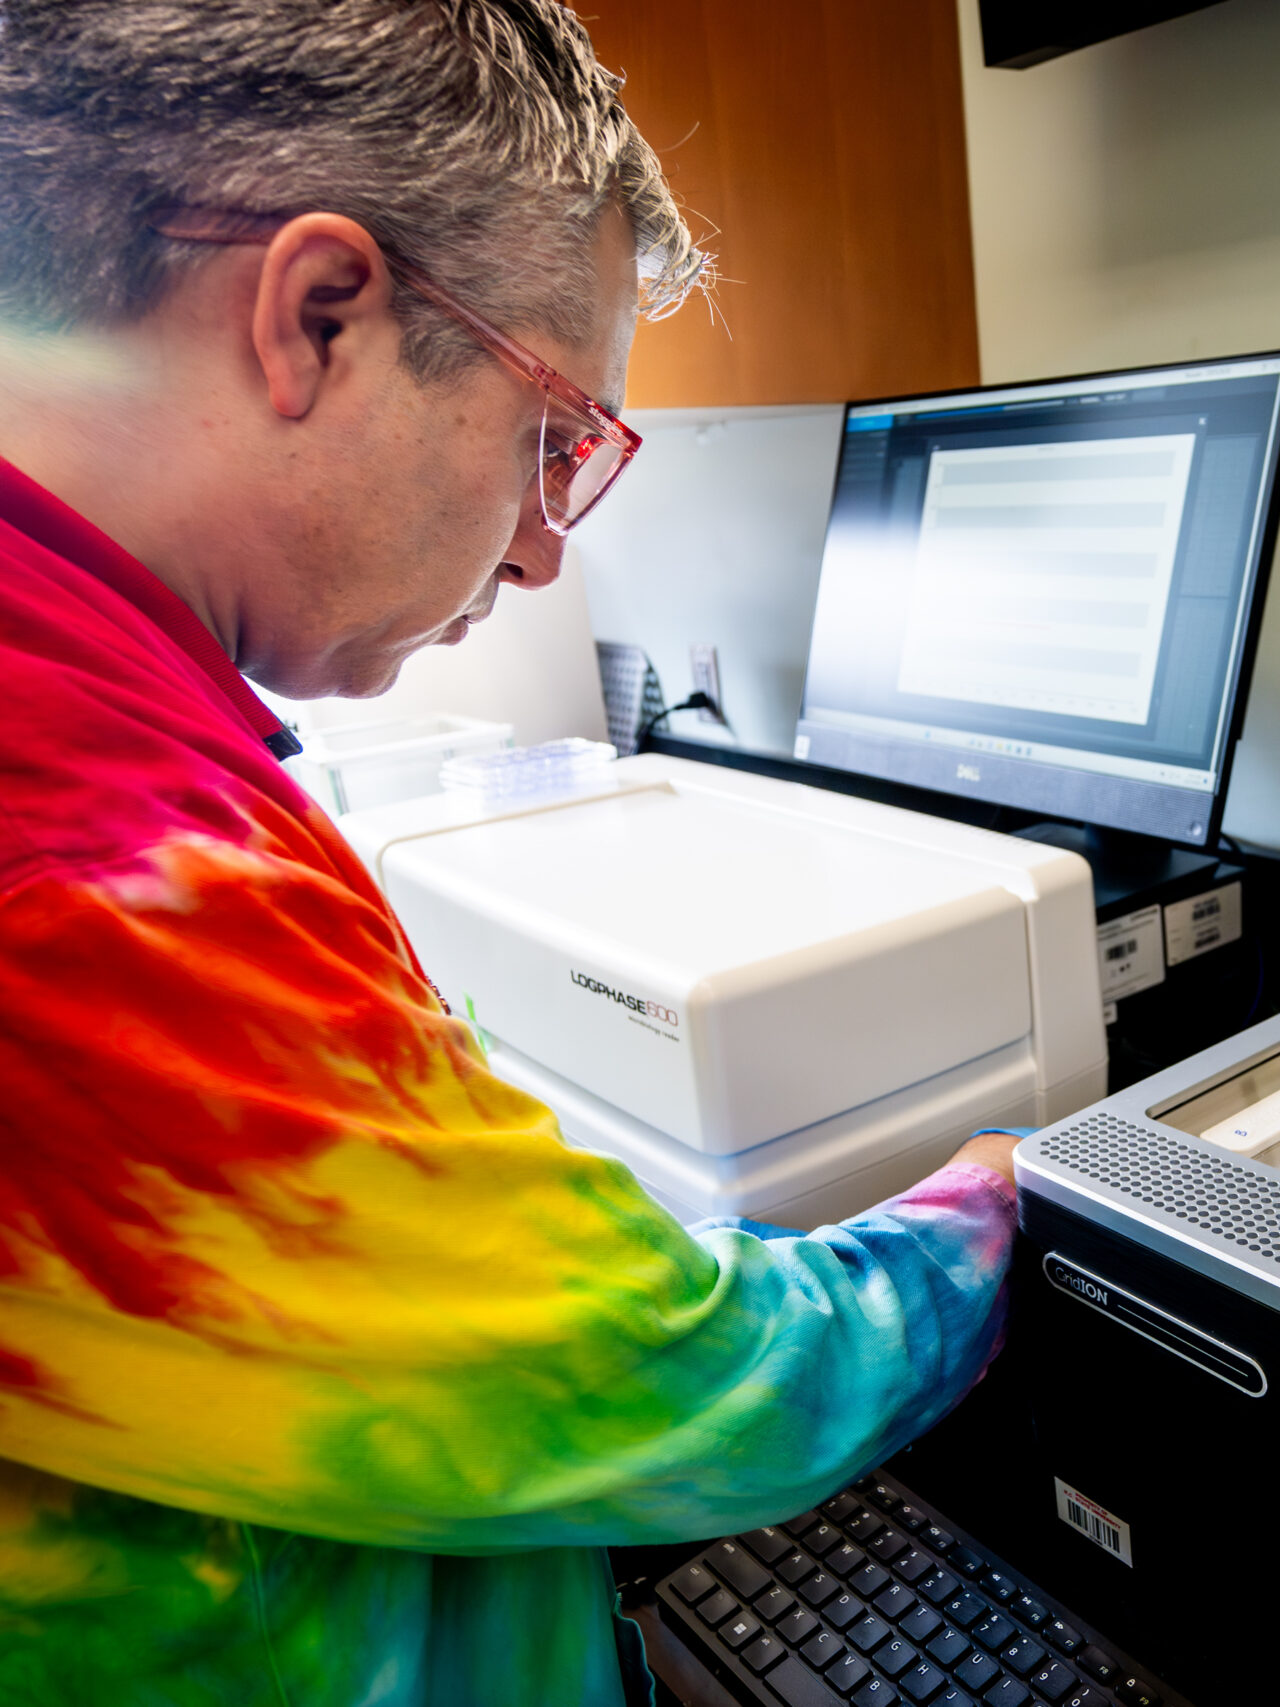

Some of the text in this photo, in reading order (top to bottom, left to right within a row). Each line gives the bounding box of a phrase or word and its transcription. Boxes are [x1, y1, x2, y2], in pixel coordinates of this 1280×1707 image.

[570, 968, 678, 1027] LOGPHASE600
[1055, 1266, 1108, 1306] GridION
[818, 1525, 828, 1535] Q
[875, 1538, 883, 1546] 3
[841, 1544, 854, 1554] W
[865, 1564, 876, 1574] E
[815, 1574, 825, 1583] S
[925, 1580, 934, 1588] 5
[770, 1588, 781, 1598] Z
[890, 1585, 900, 1595] R
[839, 1595, 849, 1604] D
[952, 1601, 961, 1609] 6
[794, 1610, 805, 1620] X
[917, 1607, 927, 1616] T
[819, 1633, 829, 1643] C
[945, 1630, 955, 1639] Y
[891, 1641, 902, 1651] G
[1009, 1648, 1018, 1656] 8
[845, 1656, 855, 1666] V
[972, 1654, 983, 1664] U
[918, 1664, 929, 1675] H
[1039, 1672, 1048, 1681] 9
[870, 1680, 880, 1691] B
[946, 1691, 957, 1700] J
[1071, 1698, 1081, 1707] 0
